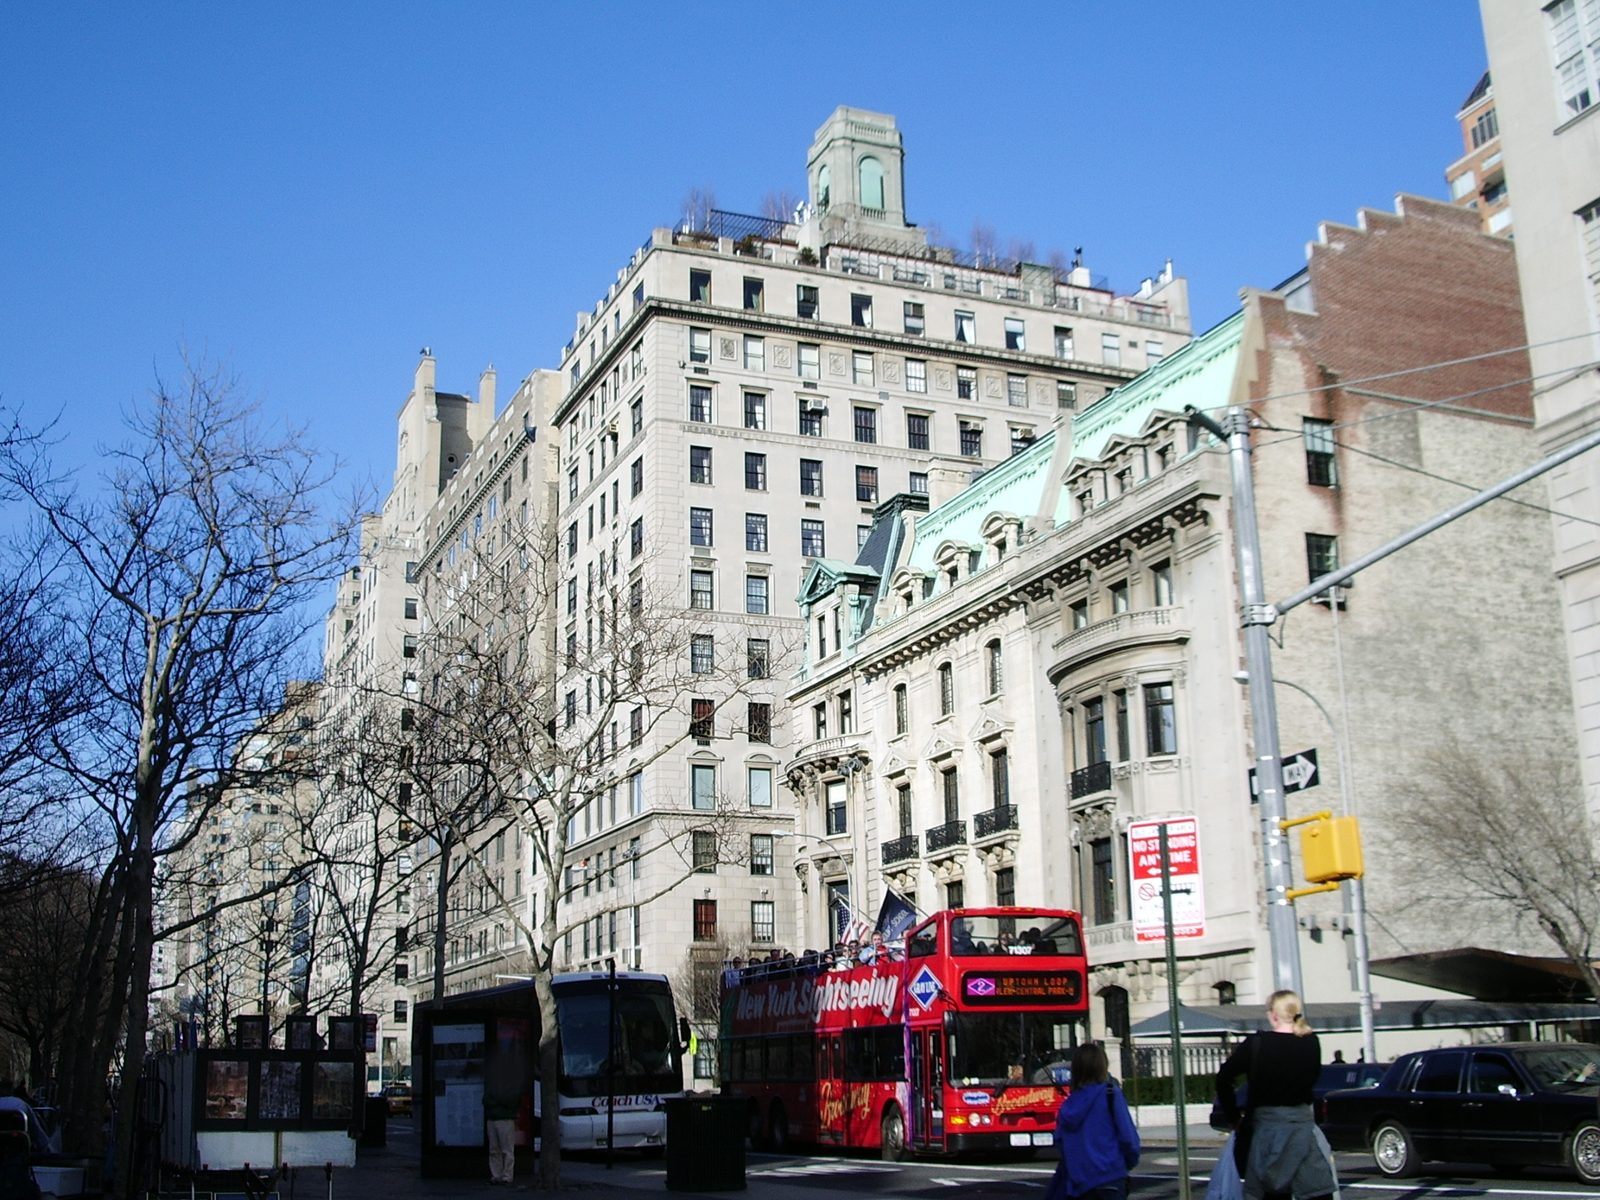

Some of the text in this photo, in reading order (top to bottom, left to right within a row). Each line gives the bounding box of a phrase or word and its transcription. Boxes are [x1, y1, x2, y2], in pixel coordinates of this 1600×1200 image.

[1286, 763, 1309, 780] WAY
[1132, 835, 1196, 853] NO STNDING
[1002, 977, 1068, 986] UPTOWN LOOP
[736, 968, 899, 1024] New York Sightseeing
[591, 1094, 661, 1107] Coach USA
[991, 1087, 1057, 1117] Broadway
